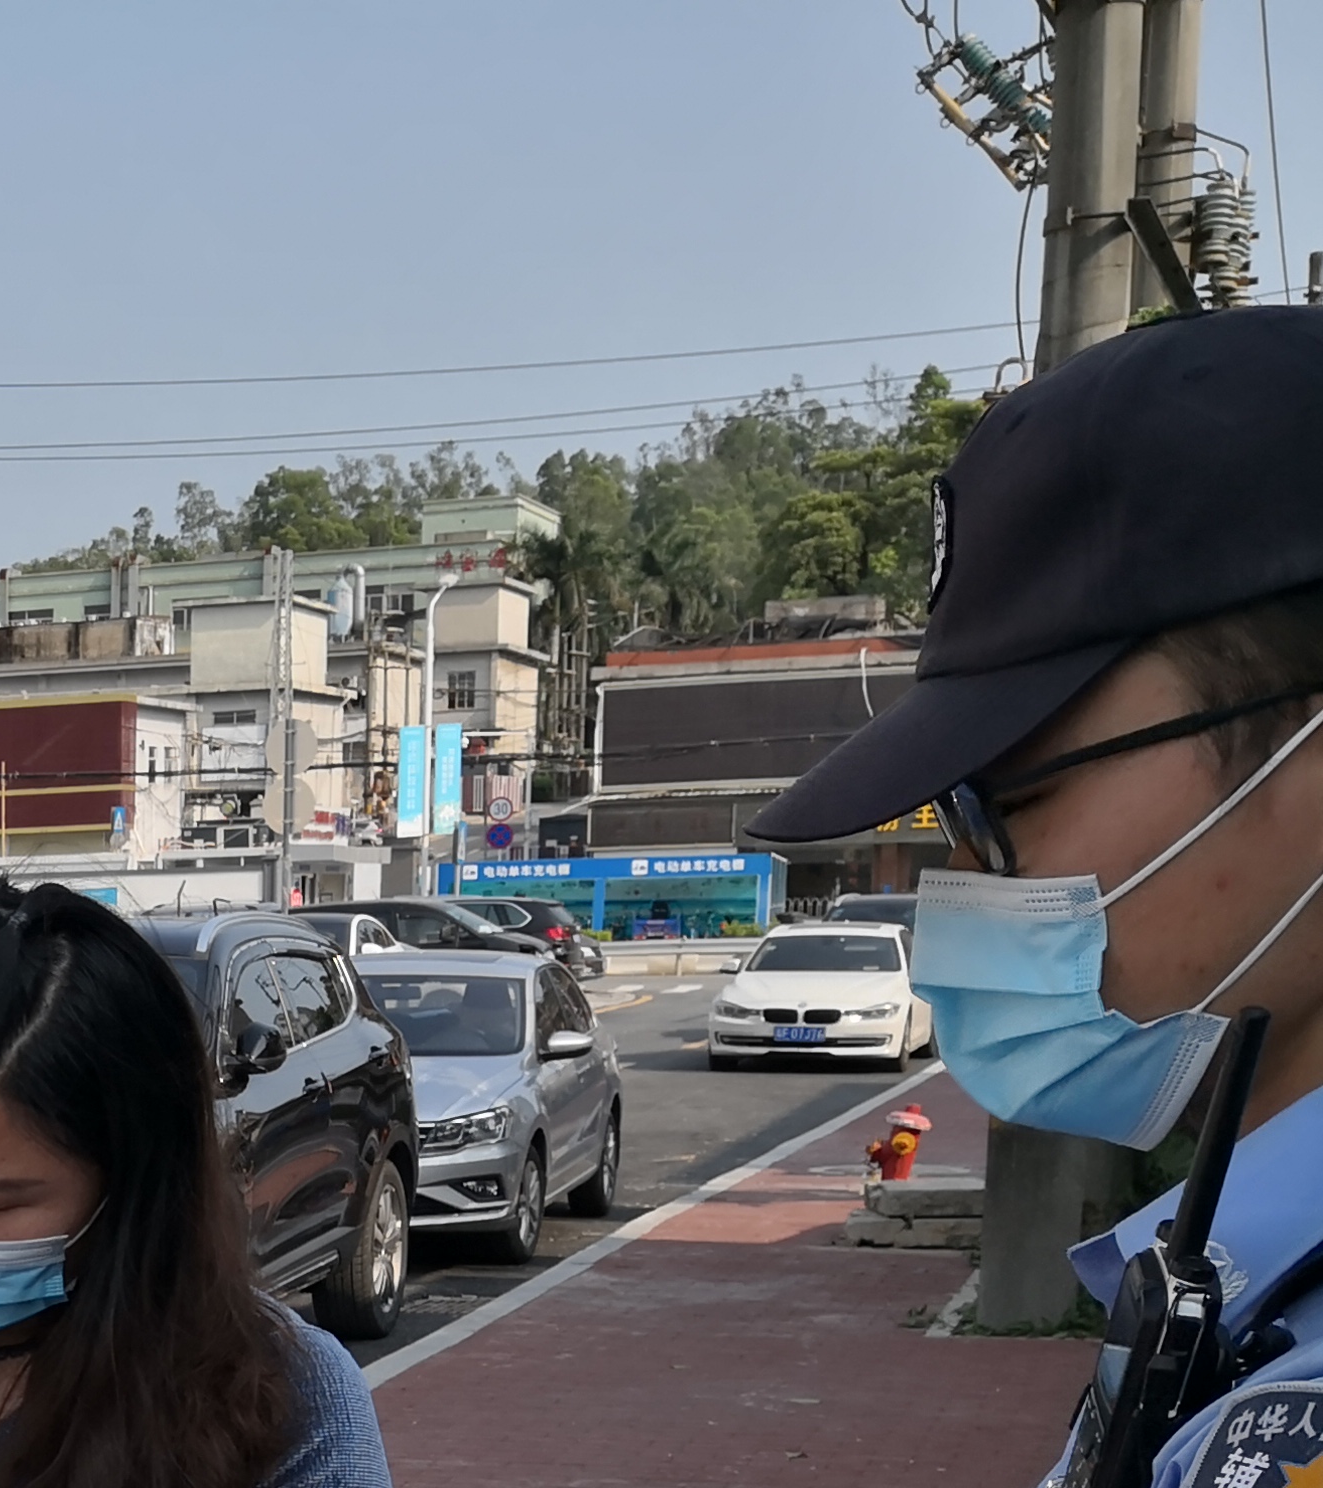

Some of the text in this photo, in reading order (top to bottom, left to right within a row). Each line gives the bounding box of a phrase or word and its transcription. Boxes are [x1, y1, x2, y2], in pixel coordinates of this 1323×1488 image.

[494, 802, 508, 816] 30
[1227, 1401, 1323, 1448] 中华人
